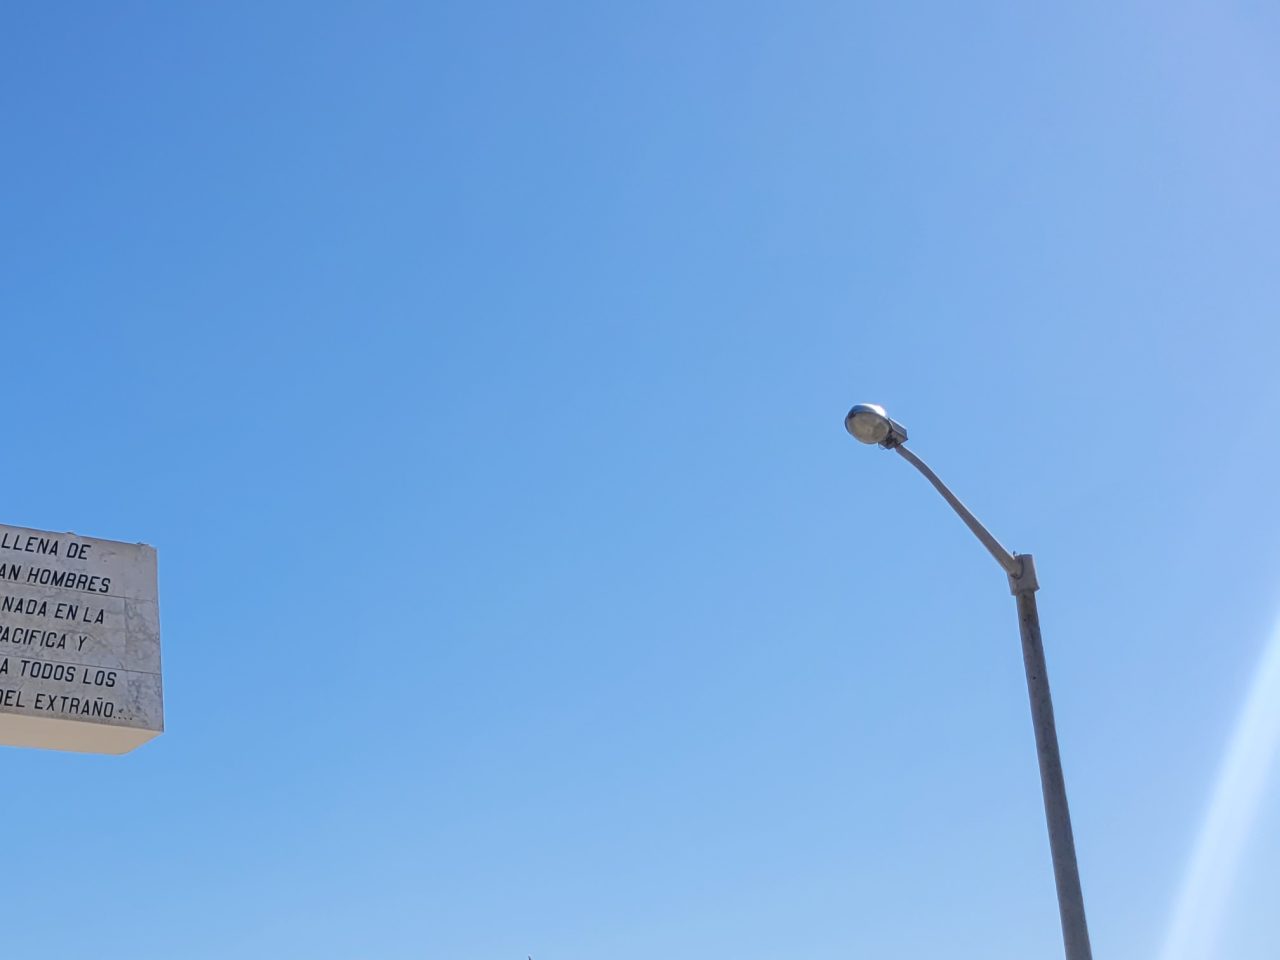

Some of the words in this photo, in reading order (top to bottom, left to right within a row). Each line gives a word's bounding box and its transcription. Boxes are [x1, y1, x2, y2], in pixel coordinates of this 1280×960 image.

[1, 533, 59, 557] LLENA
[66, 541, 92, 561] DE
[27, 568, 111, 594] HOMBRES
[1, 596, 47, 617] NADA
[54, 603, 78, 621] EN
[83, 607, 105, 625] LA
[77, 635, 88, 652] Y
[0, 657, 10, 675] A
[20, 660, 77, 683] TODOS
[82, 668, 117, 688] LOS
